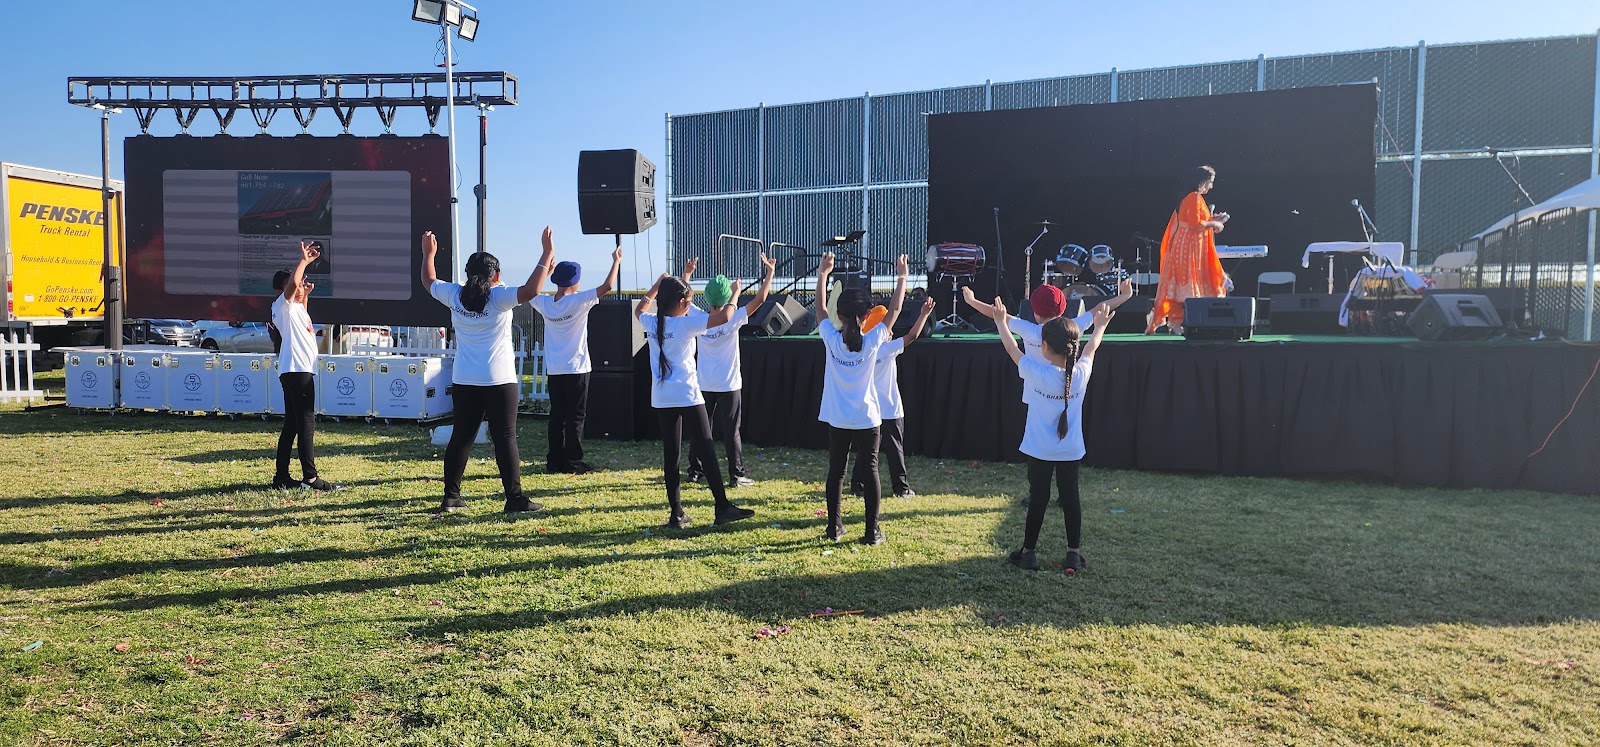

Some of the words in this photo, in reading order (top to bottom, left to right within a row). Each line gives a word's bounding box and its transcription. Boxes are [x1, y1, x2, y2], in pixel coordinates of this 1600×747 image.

[19, 202, 104, 226] PENSKE
[39, 224, 62, 235] Truck
[64, 226, 90, 237] Rental
[20, 255, 54, 263] Household
[55, 256, 60, 264] &
[61, 257, 88, 265] Business
[45, 285, 94, 294] GoPenske.com
